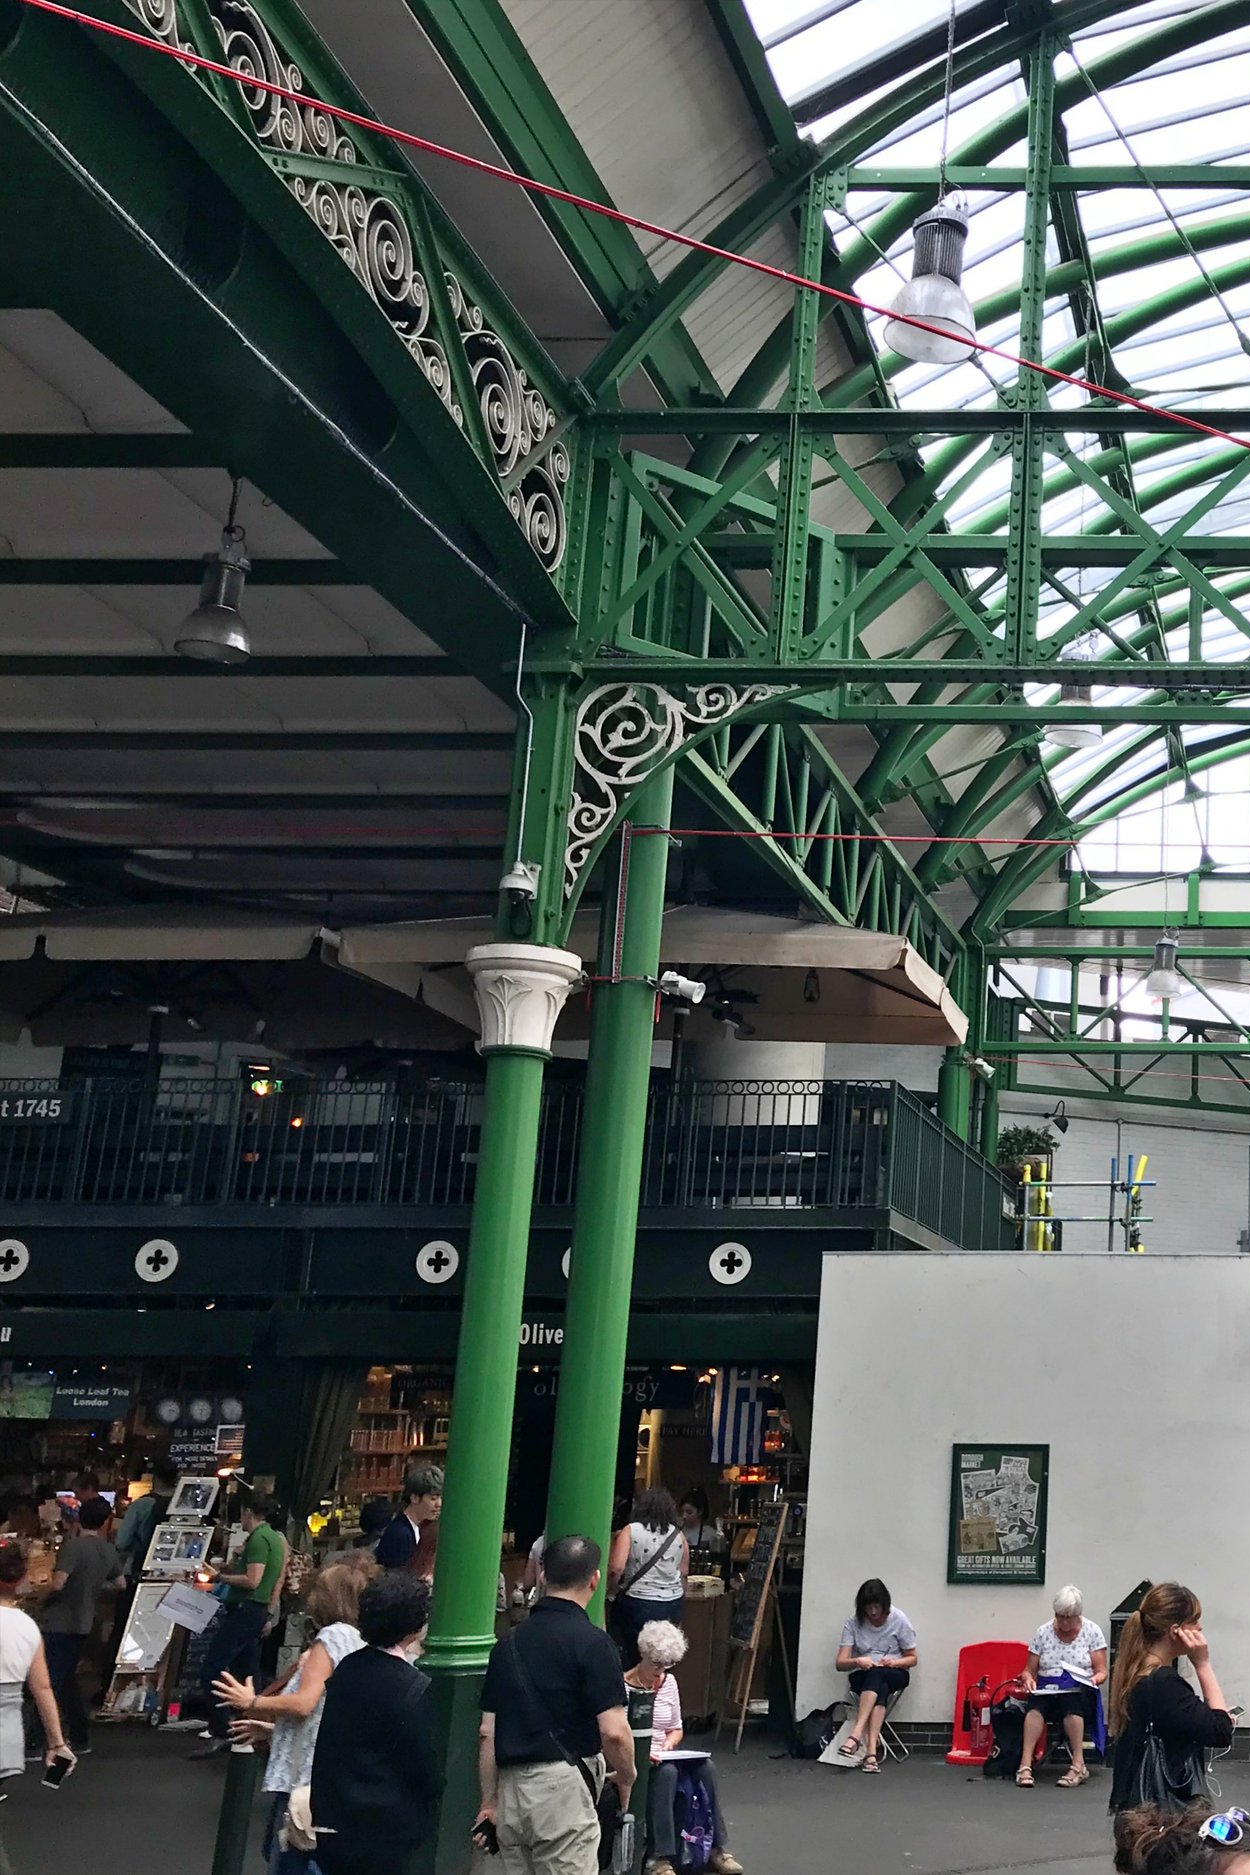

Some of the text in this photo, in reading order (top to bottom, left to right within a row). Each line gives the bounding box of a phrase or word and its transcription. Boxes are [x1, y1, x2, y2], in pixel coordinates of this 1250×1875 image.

[14, 1099, 61, 1118] 1745
[519, 1323, 564, 1345] Olive
[56, 1386, 130, 1396] Loose Leaf Tea
[73, 1398, 109, 1406] London
